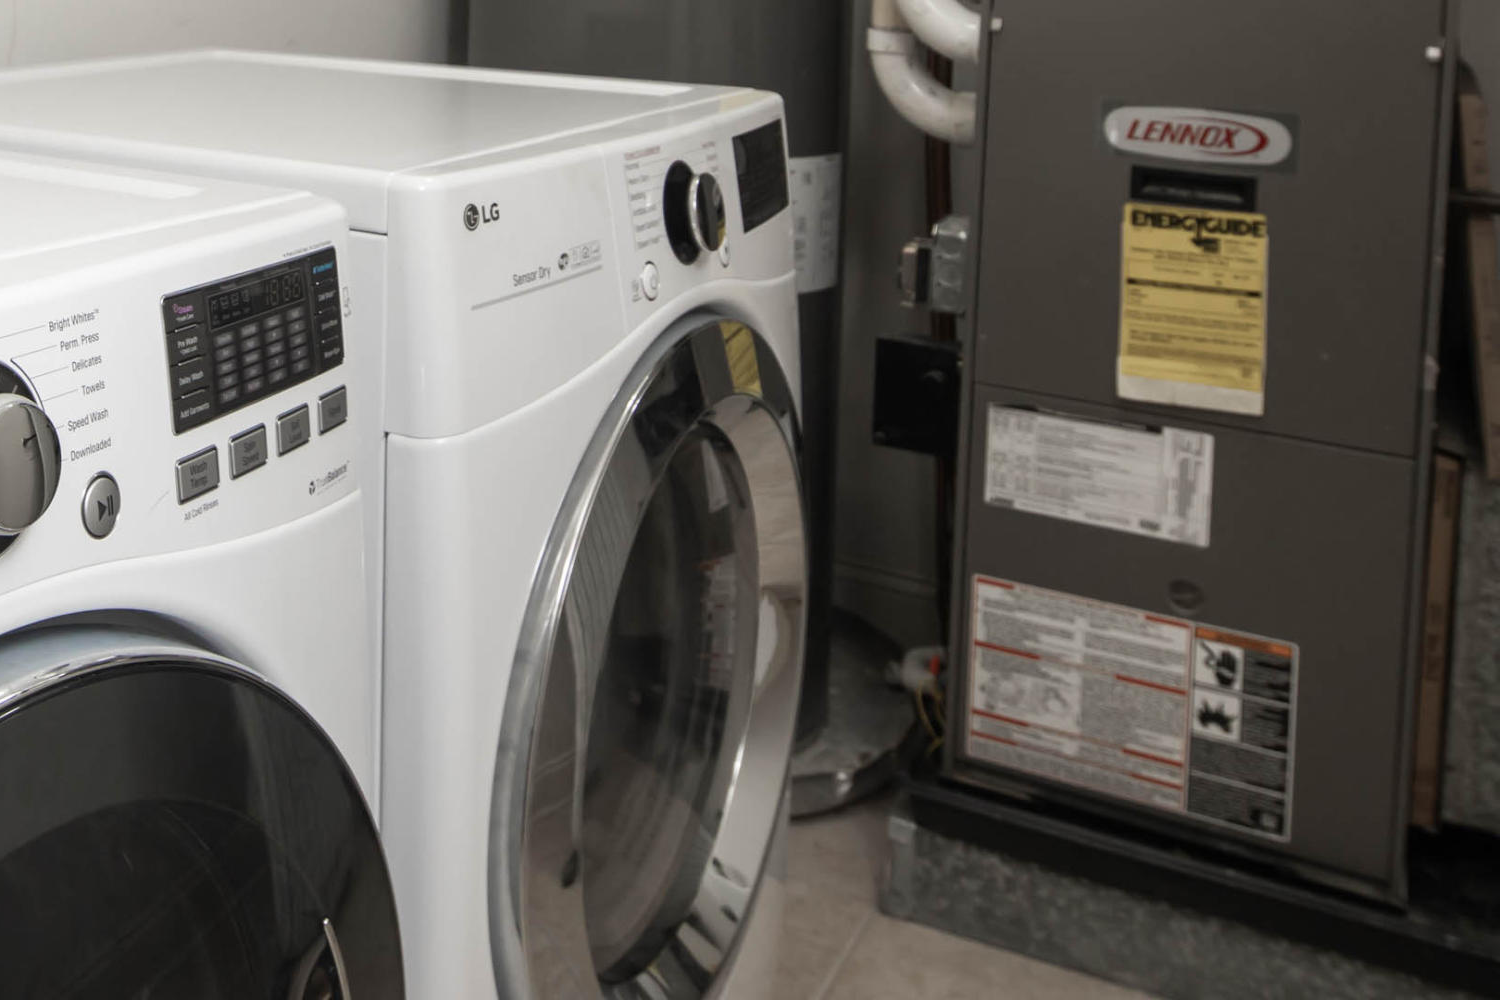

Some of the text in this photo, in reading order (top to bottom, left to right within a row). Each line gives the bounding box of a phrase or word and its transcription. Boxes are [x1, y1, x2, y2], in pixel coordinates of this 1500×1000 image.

[1126, 119, 1241, 149] LENNOX
[482, 202, 500, 223] LG
[513, 266, 551, 287] Sensor Dry
[48, 318, 71, 332] Bright
[81, 332, 100, 345] Press
[71, 355, 102, 372] Delicates
[81, 379, 106, 396] Towels
[68, 408, 109, 433] Speed Wash
[70, 437, 112, 461] Downloaded
